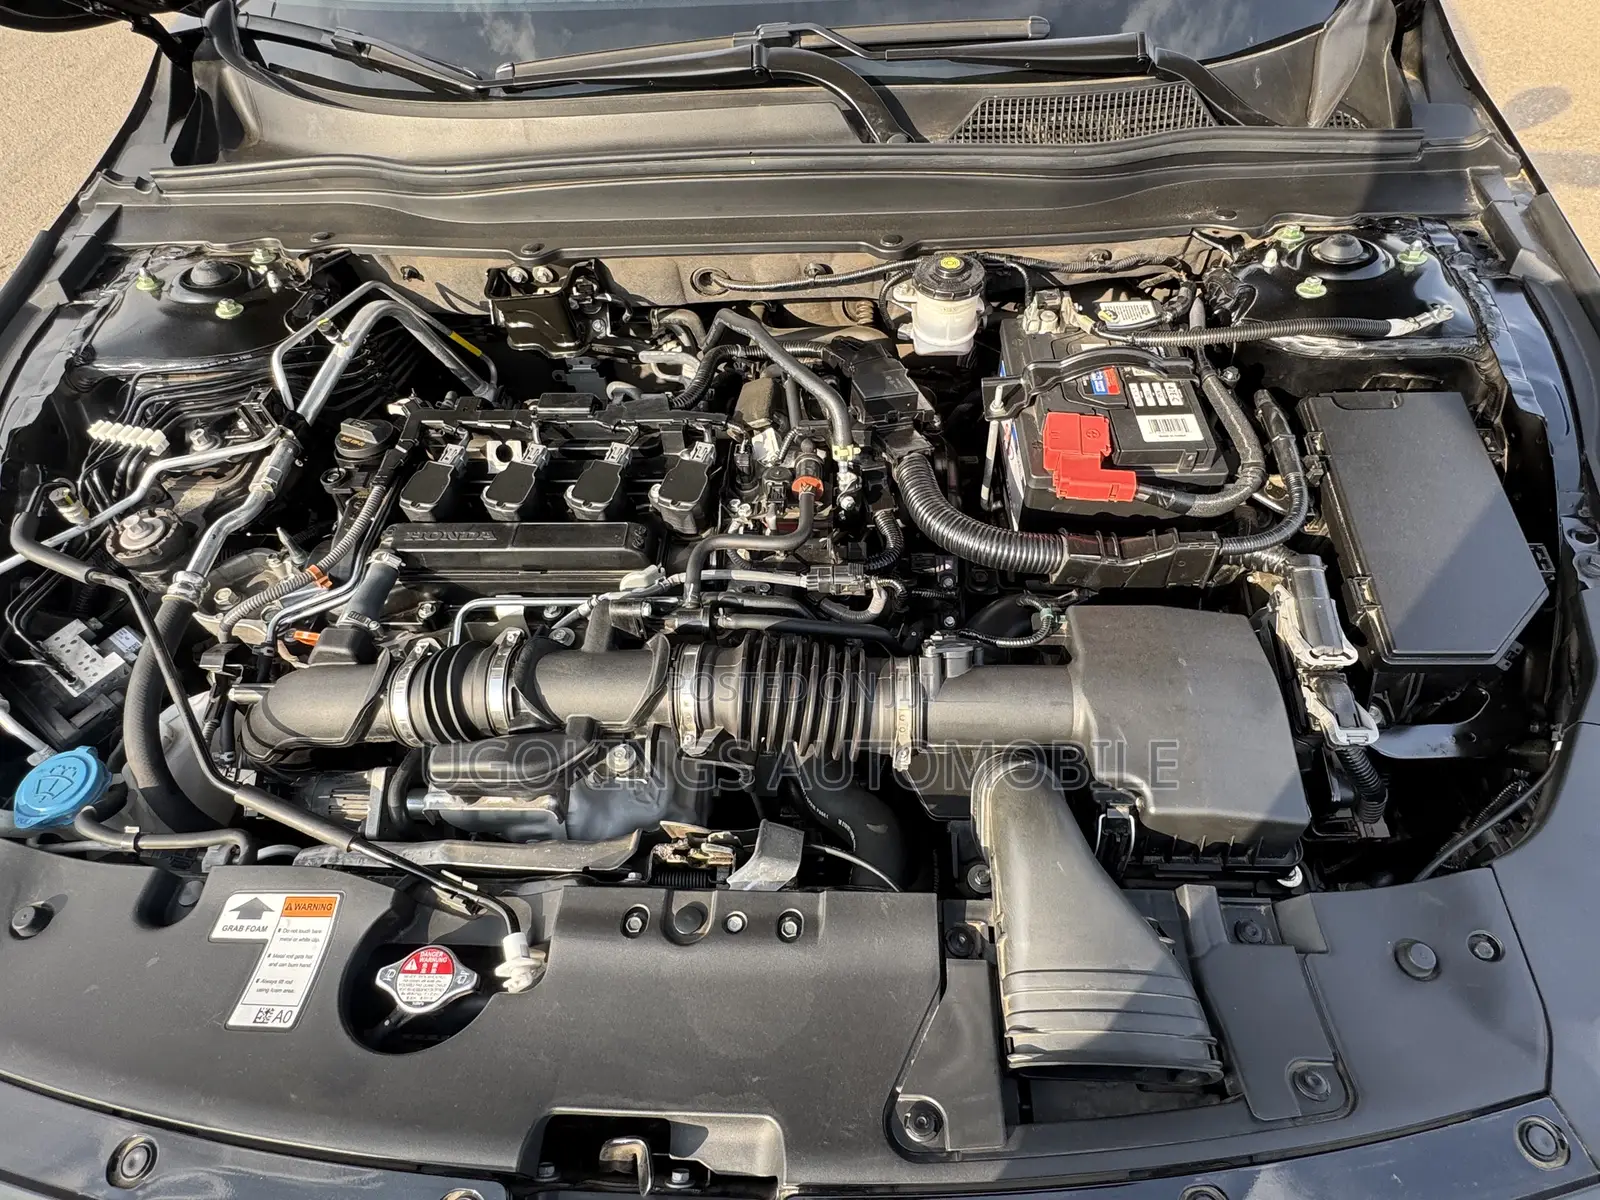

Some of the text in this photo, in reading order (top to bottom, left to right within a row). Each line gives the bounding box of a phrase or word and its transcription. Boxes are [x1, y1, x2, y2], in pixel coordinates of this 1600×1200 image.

[403, 530, 497, 541] HONDA
[293, 903, 333, 911] WARNING
[419, 956, 448, 964] WARNING
